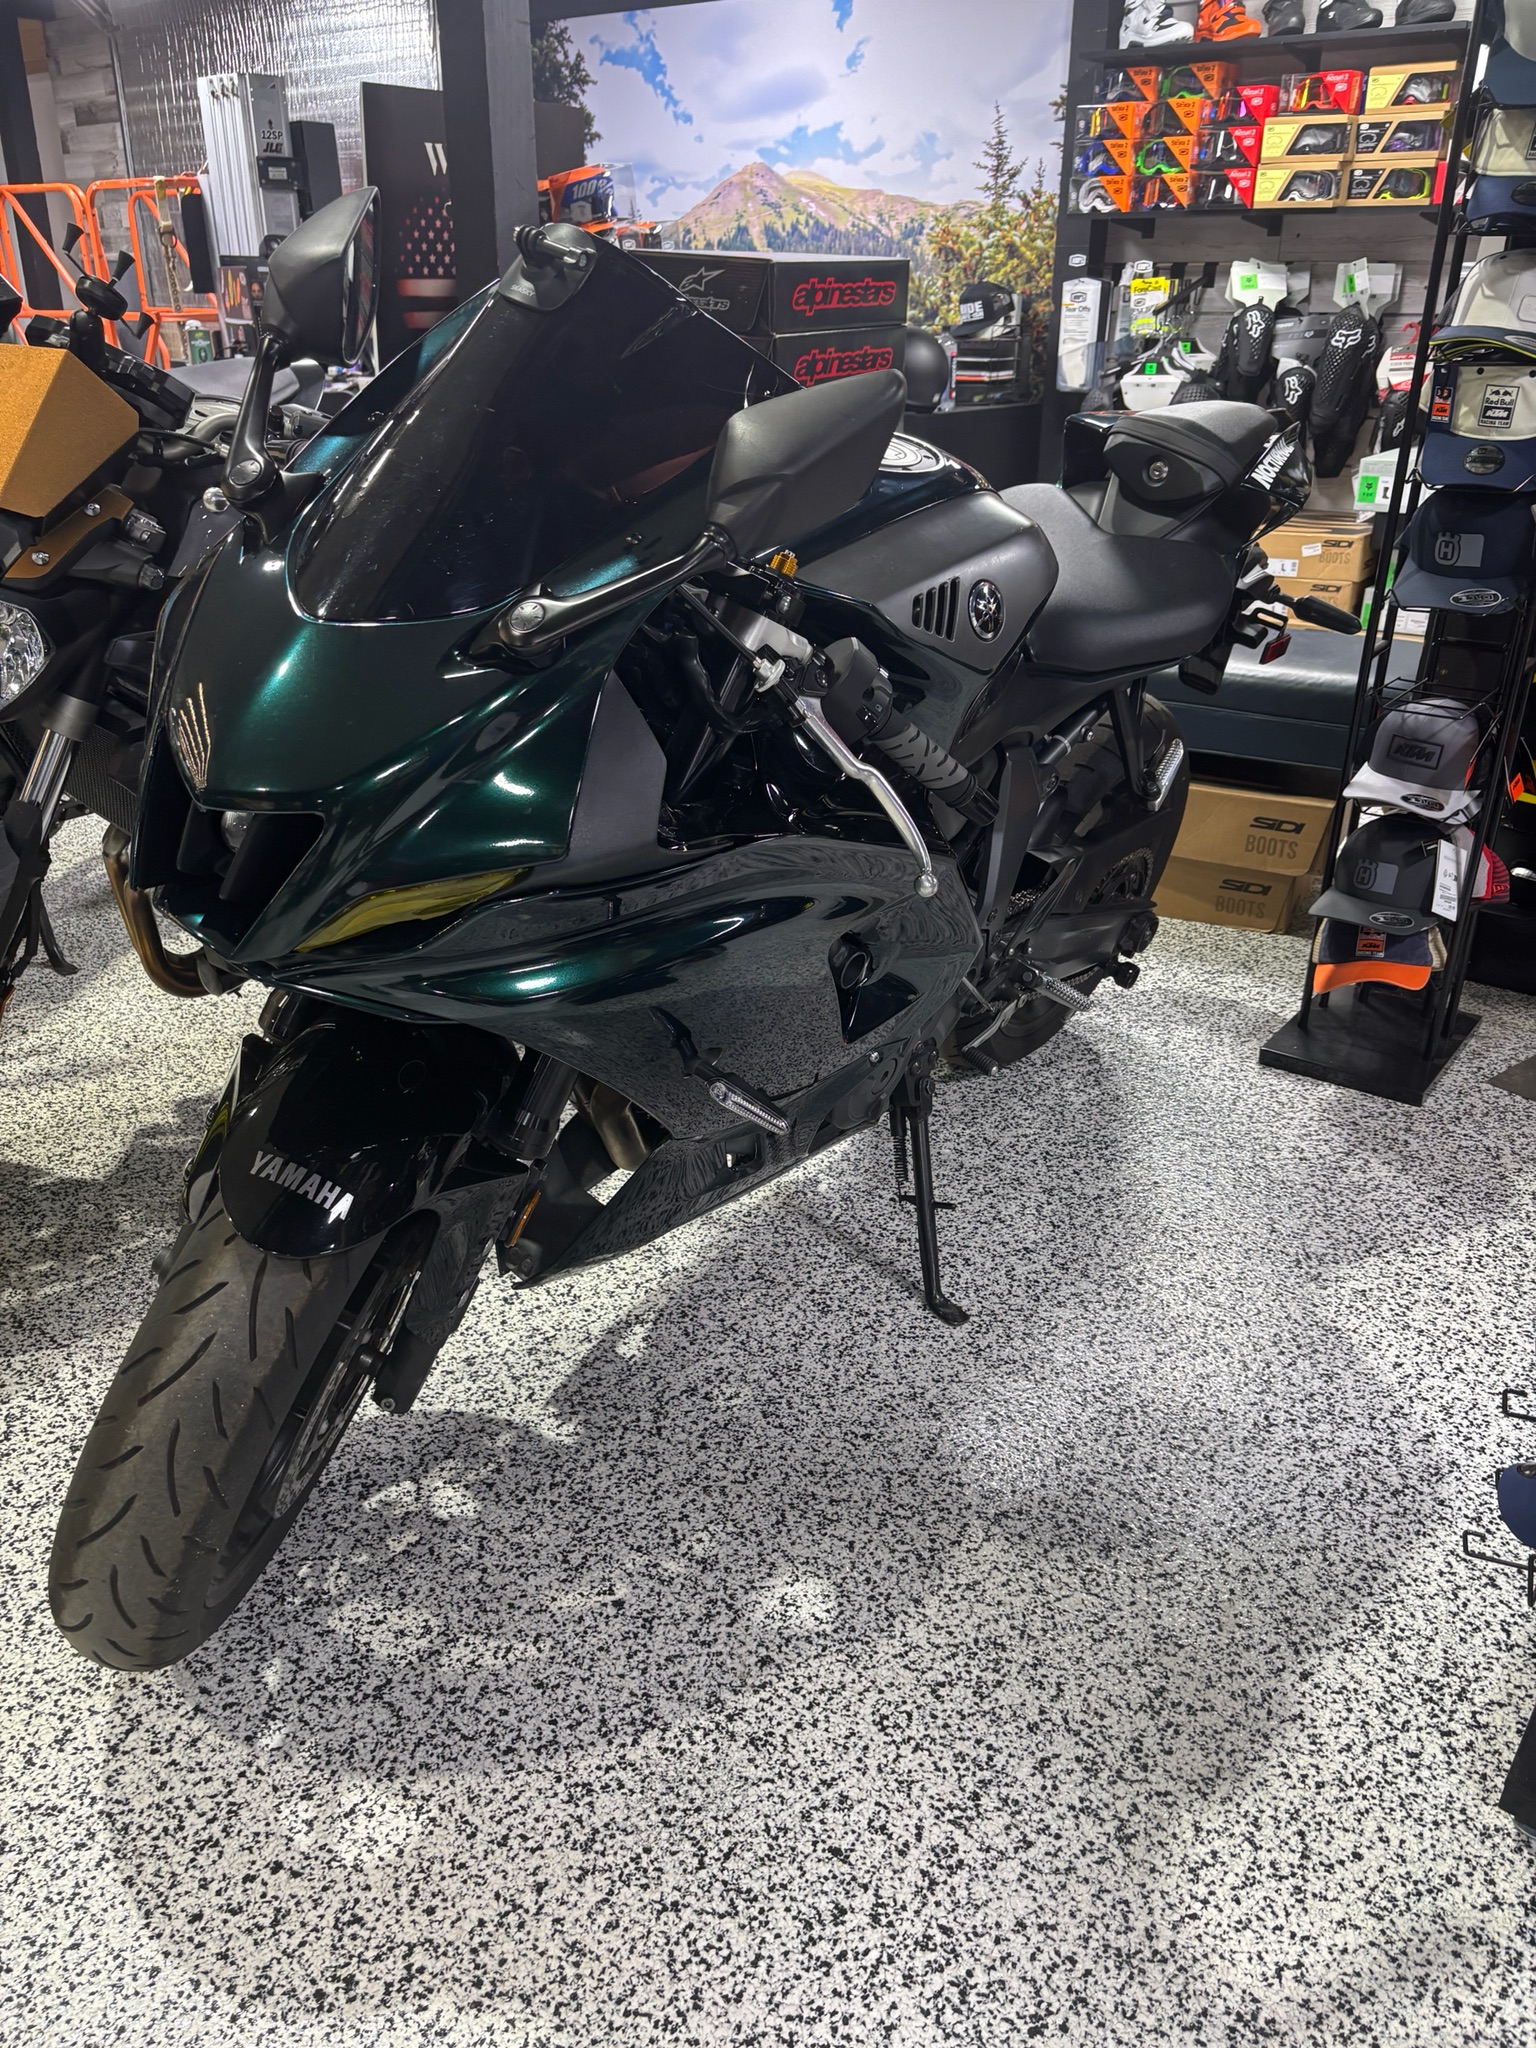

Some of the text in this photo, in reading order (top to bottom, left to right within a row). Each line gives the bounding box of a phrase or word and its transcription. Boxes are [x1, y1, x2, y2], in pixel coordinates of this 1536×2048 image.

[261, 130, 283, 140] 12SP
[792, 278, 896, 316] alpinestars
[794, 346, 893, 386] alpinestars
[1484, 397, 1514, 407] Red Bull
[1485, 409, 1509, 418] KTM
[1319, 552, 1351, 564] BOOTS
[1394, 742, 1436, 762] KTM
[1244, 834, 1298, 859] BOOTS
[1215, 896, 1266, 919] BOOTS
[250, 1150, 354, 1222] YAMAHA
